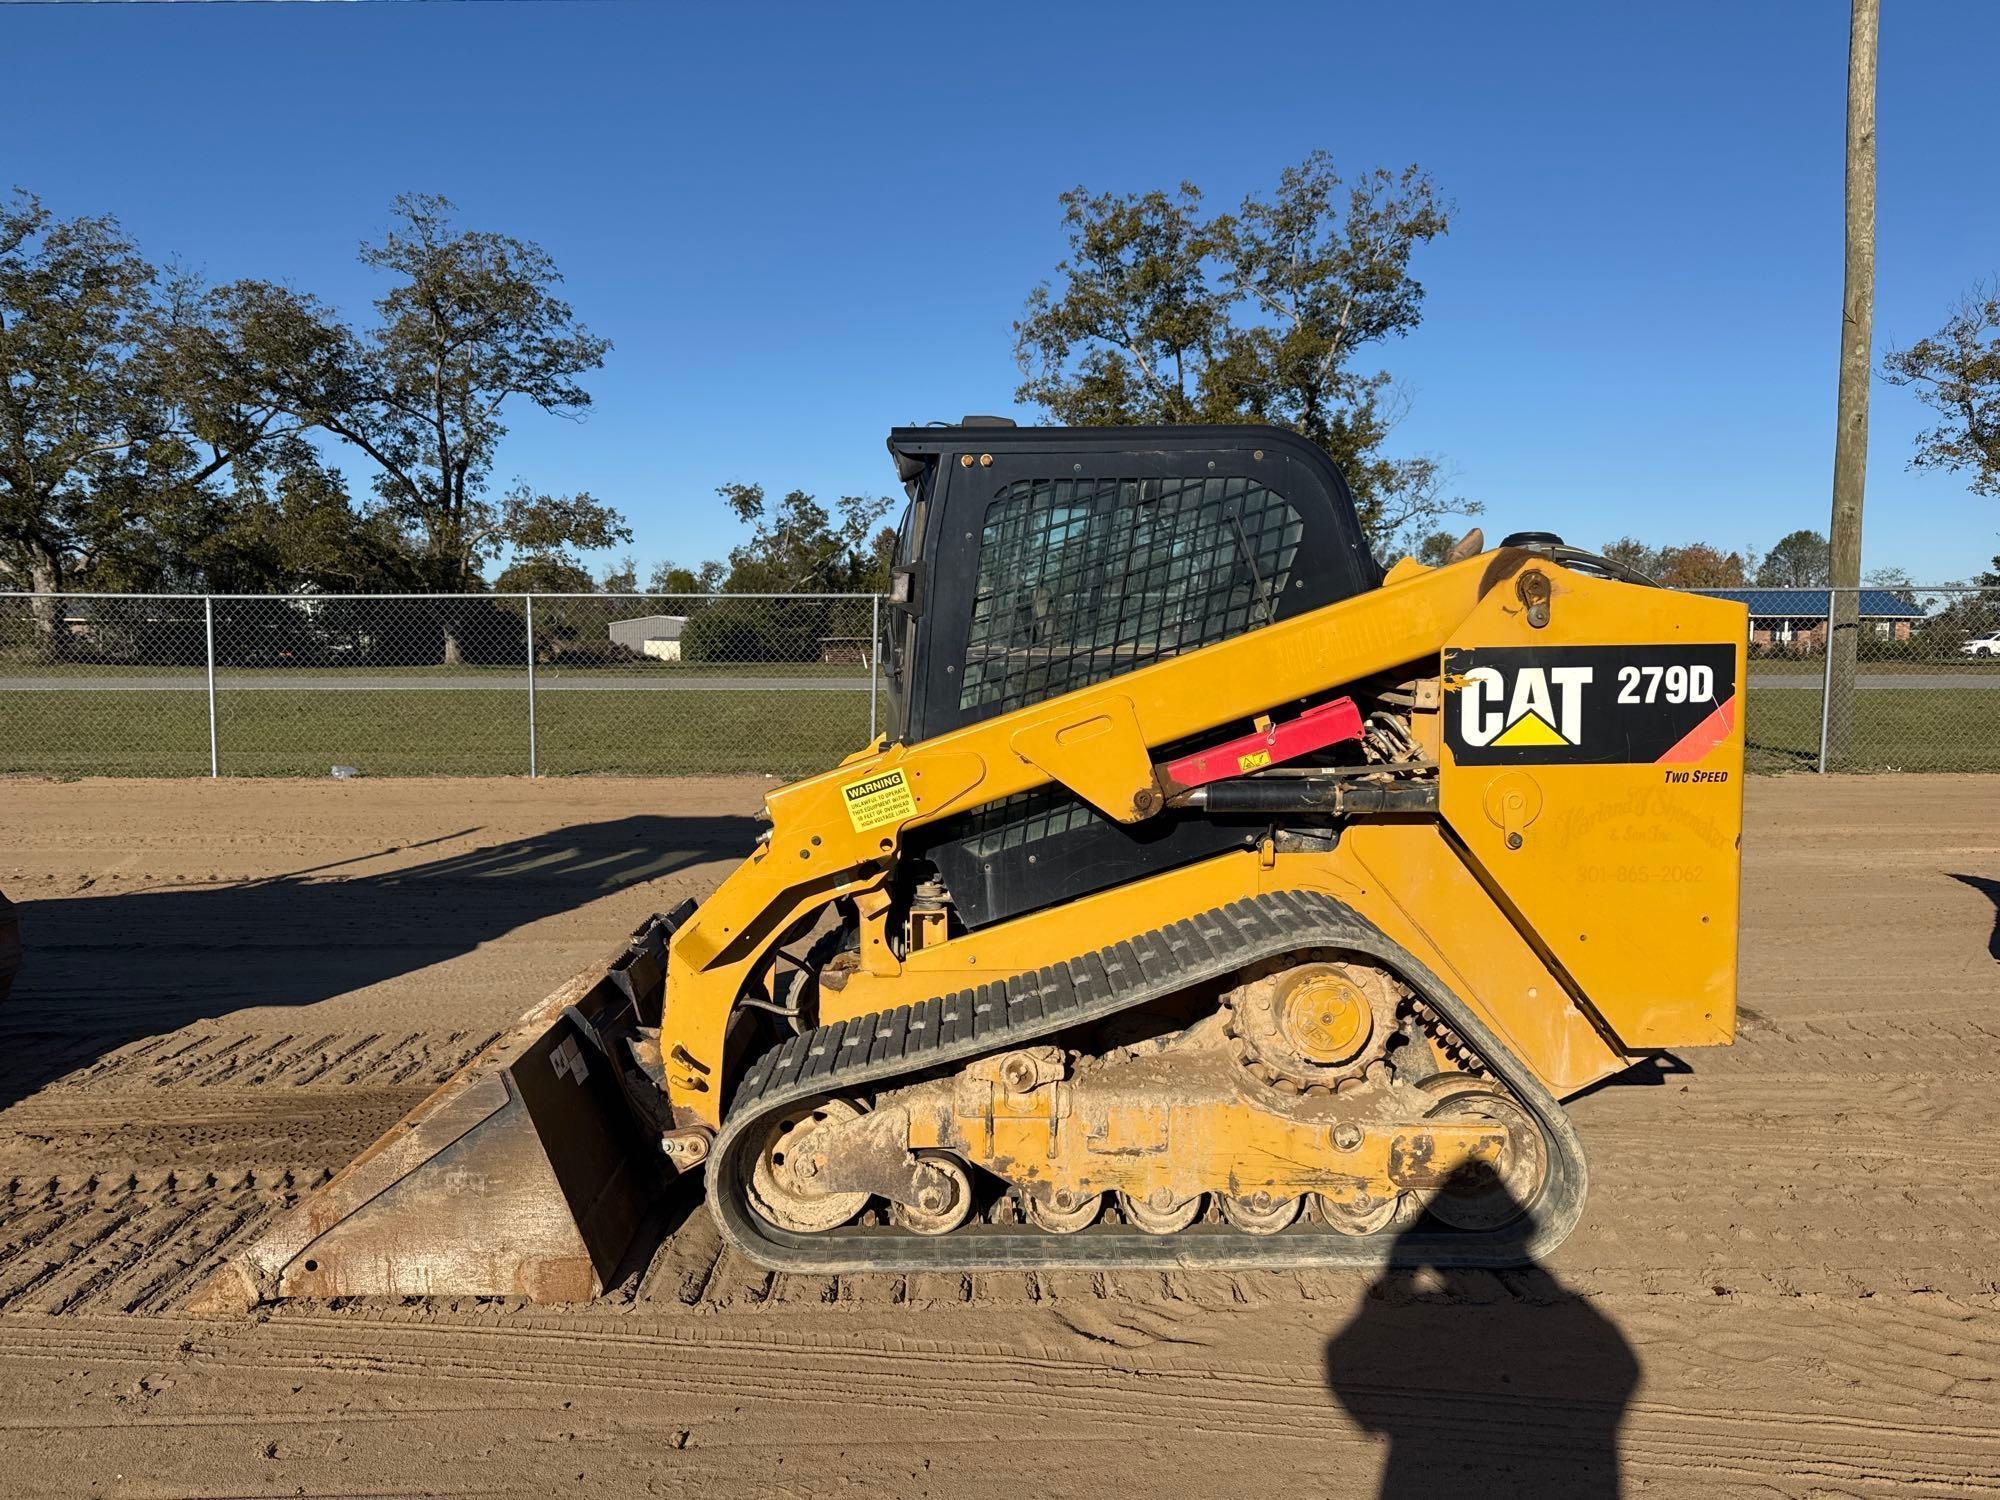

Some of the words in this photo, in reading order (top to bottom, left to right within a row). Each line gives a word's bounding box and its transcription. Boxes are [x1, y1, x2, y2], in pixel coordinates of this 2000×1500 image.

[1461, 667, 1593, 747] CAT
[1617, 665, 1714, 704] 279D
[848, 774, 901, 798] WARNING
[851, 797, 878, 809] UNLAWFUL
[885, 787, 906, 798] OPERATE
[852, 807, 864, 816] THIS
[864, 800, 891, 812] EQUIPMENT
[892, 793, 910, 803] WITHIN
[861, 819, 874, 827] HIGH
[874, 812, 895, 823] VOLTAGE
[895, 807, 910, 818] LINES
[864, 811, 876, 820] FEET
[884, 800, 909, 813] OVERHEAD
[1577, 865, 1704, 883] 301-865-2062
